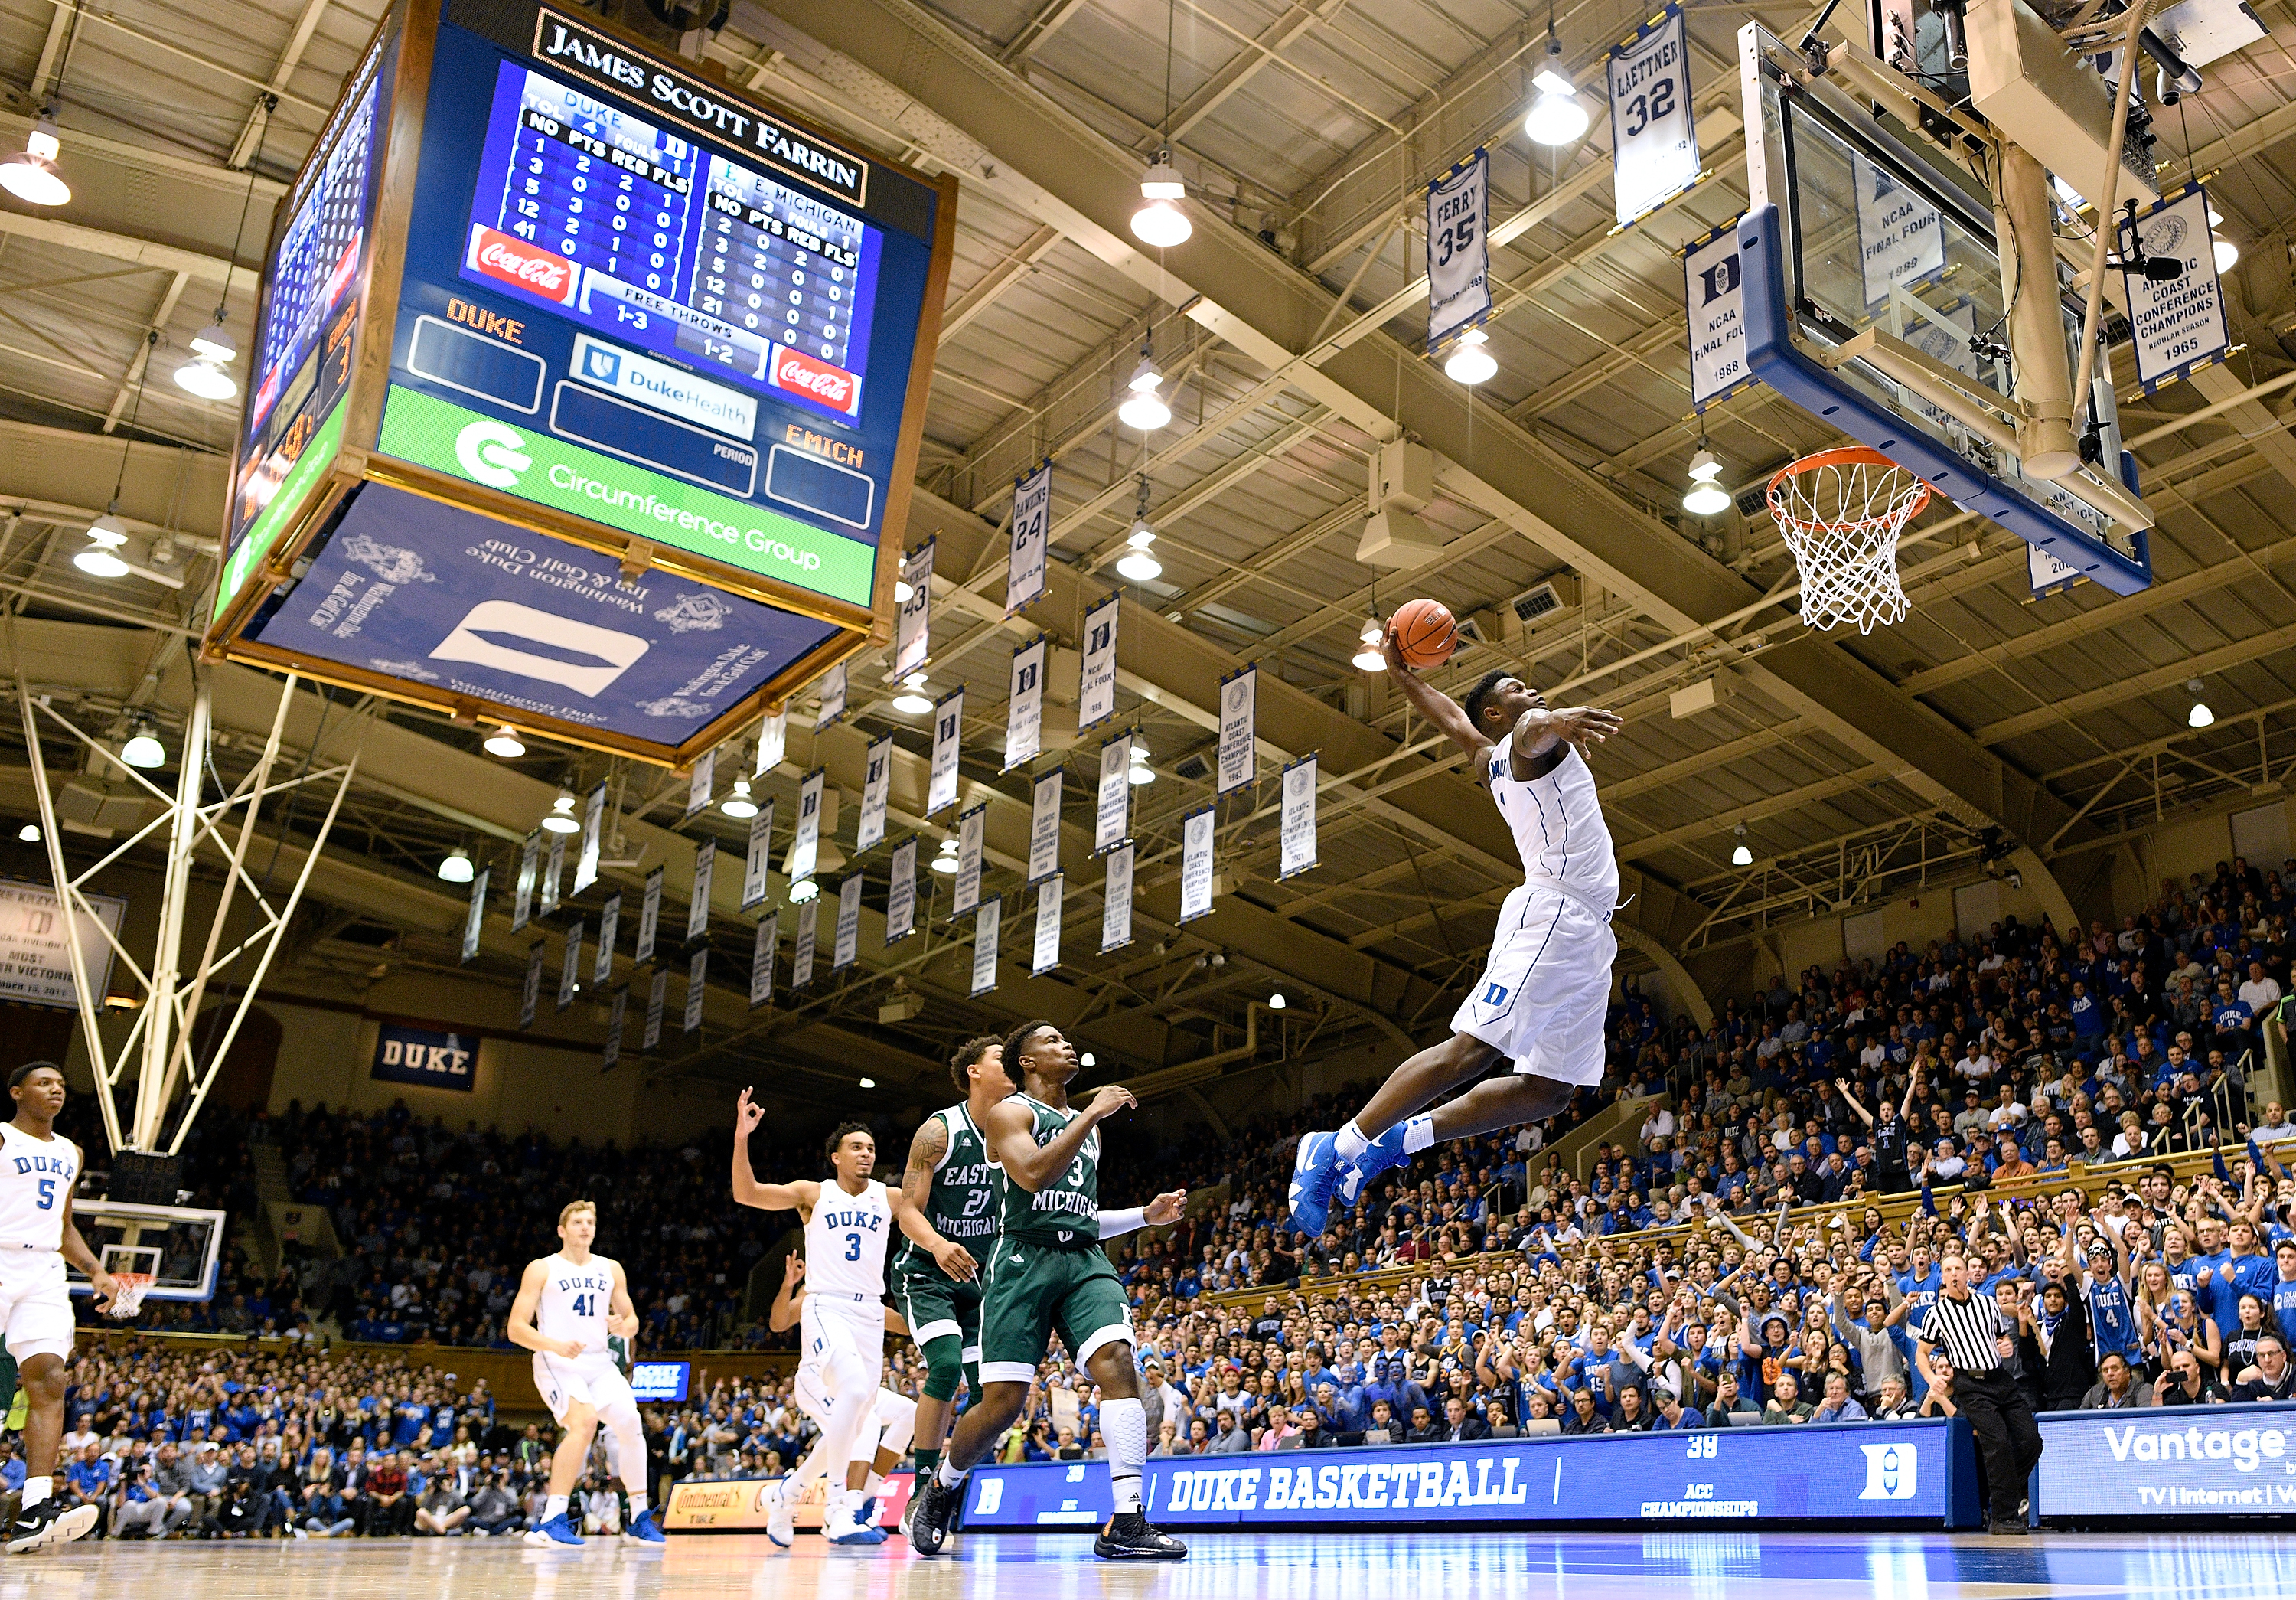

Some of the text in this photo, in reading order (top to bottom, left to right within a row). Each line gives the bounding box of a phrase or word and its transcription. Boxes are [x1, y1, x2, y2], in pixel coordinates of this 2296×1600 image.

[1617, 38, 1678, 99] LAETTNER
[546, 24, 858, 190] JAMES SCOTT FARRIN
[565, 90, 623, 129] DUKE
[1626, 77, 1675, 137] 32
[527, 93, 681, 174] TOL 4 FOULS 1
[530, 112, 689, 194] NO PTS REB FLS
[536, 138, 672, 207] 1 2 2 1
[528, 157, 671, 228] 3 0 0 0
[755, 178, 856, 235] E. MICHIGAN
[1436, 183, 1478, 228] FERRY
[524, 178, 667, 249] 5 3 0 0
[713, 177, 851, 250] TOL 3 FOULS 1
[1881, 201, 1914, 230] NCAA
[517, 197, 664, 269] 12 2 1 0
[714, 194, 856, 269] NO PTS REB FLS
[1437, 212, 1476, 268] 35
[1866, 211, 1936, 260] FINAL FOUR
[513, 219, 661, 290] 41 0 1 0
[717, 217, 845, 282] 2 0 2 0
[480, 242, 567, 291] Coca-Cola
[714, 237, 842, 302] 3 2 0 0
[1888, 256, 1919, 280] 1989
[711, 256, 837, 320] 5 0 0 1
[2152, 276, 2191, 303] COAST
[616, 304, 649, 331] 1-3
[625, 288, 732, 339] FREE THROWS
[706, 275, 837, 341] 12 0 0 0
[2135, 280, 2215, 327] CONFERENCE
[2140, 297, 2213, 339] CHAMPIONS
[446, 296, 526, 345] DUKE
[701, 294, 833, 360] 21 0 0 0
[1708, 309, 1737, 333] NCAA
[2148, 317, 2210, 351] REGULAR SEASON
[703, 338, 734, 365] 1-2
[1694, 322, 1746, 361] FINAL FOU
[2164, 337, 2199, 361] 1965
[779, 360, 852, 403] Coca-Cola
[1714, 360, 1740, 383] 1988
[630, 369, 748, 426] DukeHealth
[713, 442, 754, 468] PERIOD
[784, 423, 865, 469] EMICH
[549, 462, 822, 573] Circumference Group
[1016, 510, 1042, 551] 24
[484, 537, 536, 565] Club
[465, 546, 644, 615] Washington Duke
[536, 557, 589, 583] Golf
[590, 573, 612, 589] &
[903, 584, 926, 618] 43
[1225, 715, 1248, 733] ATLANTIC
[1228, 727, 1245, 741] COAST
[1219, 731, 1251, 756] CONFERENCE
[1220, 743, 1250, 765] CHAMPIONS
[1103, 776, 1124, 792] ATLANTIC
[1105, 787, 1120, 801] COAST
[1097, 793, 1127, 813] CONFERENCE
[1097, 804, 1124, 822] CHAMPIONS
[1288, 800, 1309, 816] ATLANTIC
[1290, 811, 1306, 824] COAST
[1186, 849, 1208, 863] ATLANTIC
[1189, 859, 1204, 870] COAST
[8, 950, 46, 964] MOST
[43, 985, 67, 998] 2011
[2219, 1010, 2242, 1024] DUKE
[382, 1039, 471, 1076] DUKE
[1724, 1125, 1740, 1138] DUKE
[1883, 1137, 1890, 1149] 1
[13, 1155, 74, 1183] DUKE
[943, 1163, 993, 1186] EAST
[1068, 1155, 1084, 1187] 3
[36, 1178, 55, 1210] 5
[961, 1188, 991, 1217] 21
[824, 1210, 882, 1233] DUKE
[844, 1233, 861, 1262] 3
[557, 1276, 608, 1292] DUKE
[572, 1293, 595, 1317] 41
[2094, 1291, 2121, 1309] DUKE
[2105, 1308, 2119, 1328] 4
[1686, 1433, 1719, 1459] 39
[2103, 1425, 2287, 1473] Vantage
[1167, 1456, 1528, 1513] DUKE BASKETBALL
[1684, 1483, 1714, 1500] ACC
[2137, 1486, 2263, 1505] TV Internet
[676, 1486, 740, 1515] Continental
[1640, 1500, 1760, 1517] CHAMPIONSHIPS
[689, 1513, 716, 1525] TIRE
